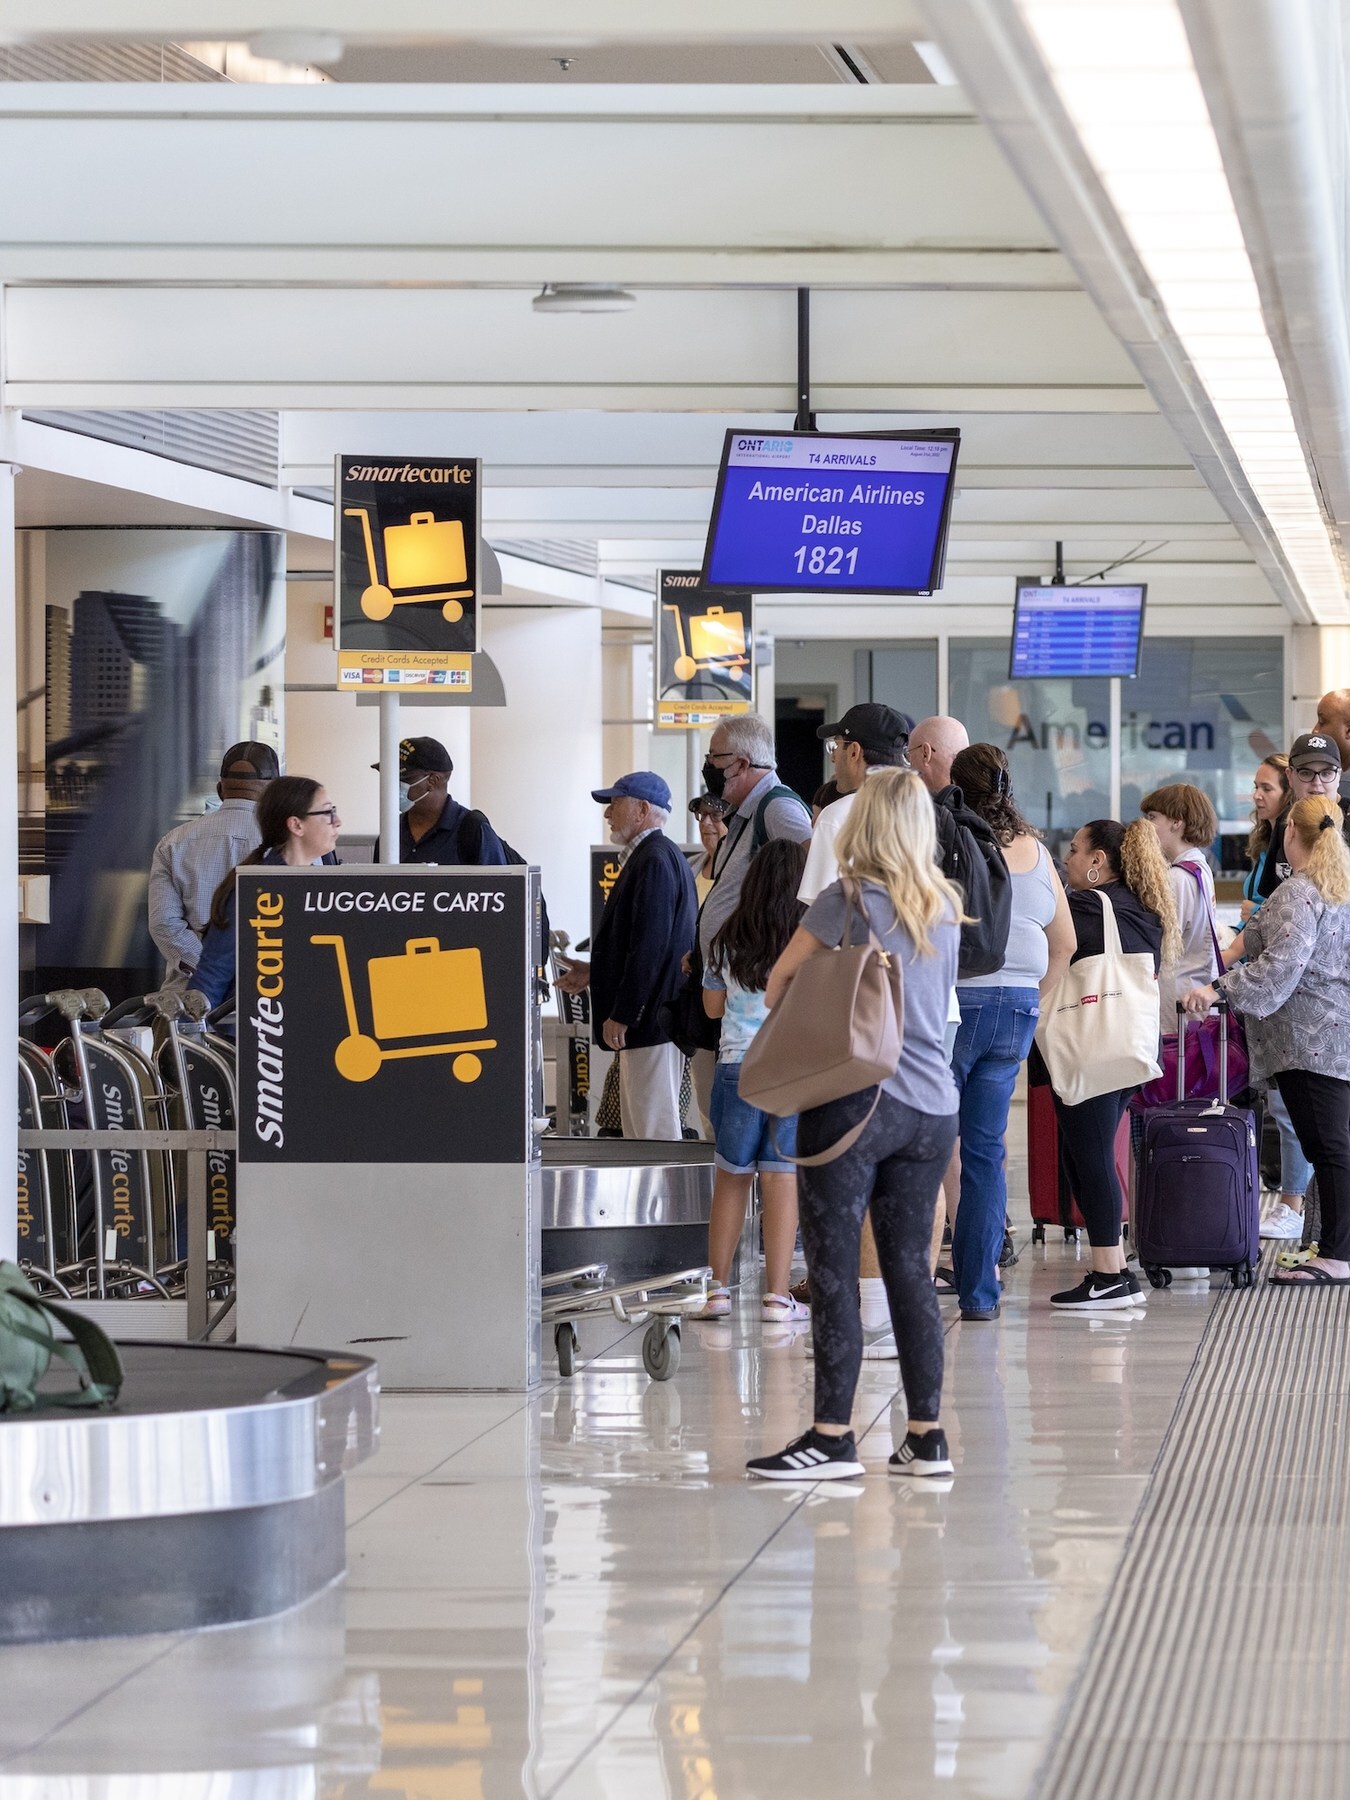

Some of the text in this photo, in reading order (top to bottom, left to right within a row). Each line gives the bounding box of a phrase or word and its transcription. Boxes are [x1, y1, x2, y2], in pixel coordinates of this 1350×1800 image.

[737, 439, 793, 452] ONTARIO
[808, 453, 877, 466] T4 ARRIVALS
[345, 463, 472, 484] smartecarte
[748, 480, 925, 506] American Airlines
[801, 514, 863, 535] Dallas
[793, 545, 859, 575] 1821
[360, 654, 448, 665] Credit Cards Accepted
[343, 671, 361, 679] VISA
[673, 703, 690, 711] Credit
[1007, 712, 1215, 750] Ameican
[304, 891, 506, 913] LUGGAGE CARTS
[249, 891, 284, 1149] smartecarte
